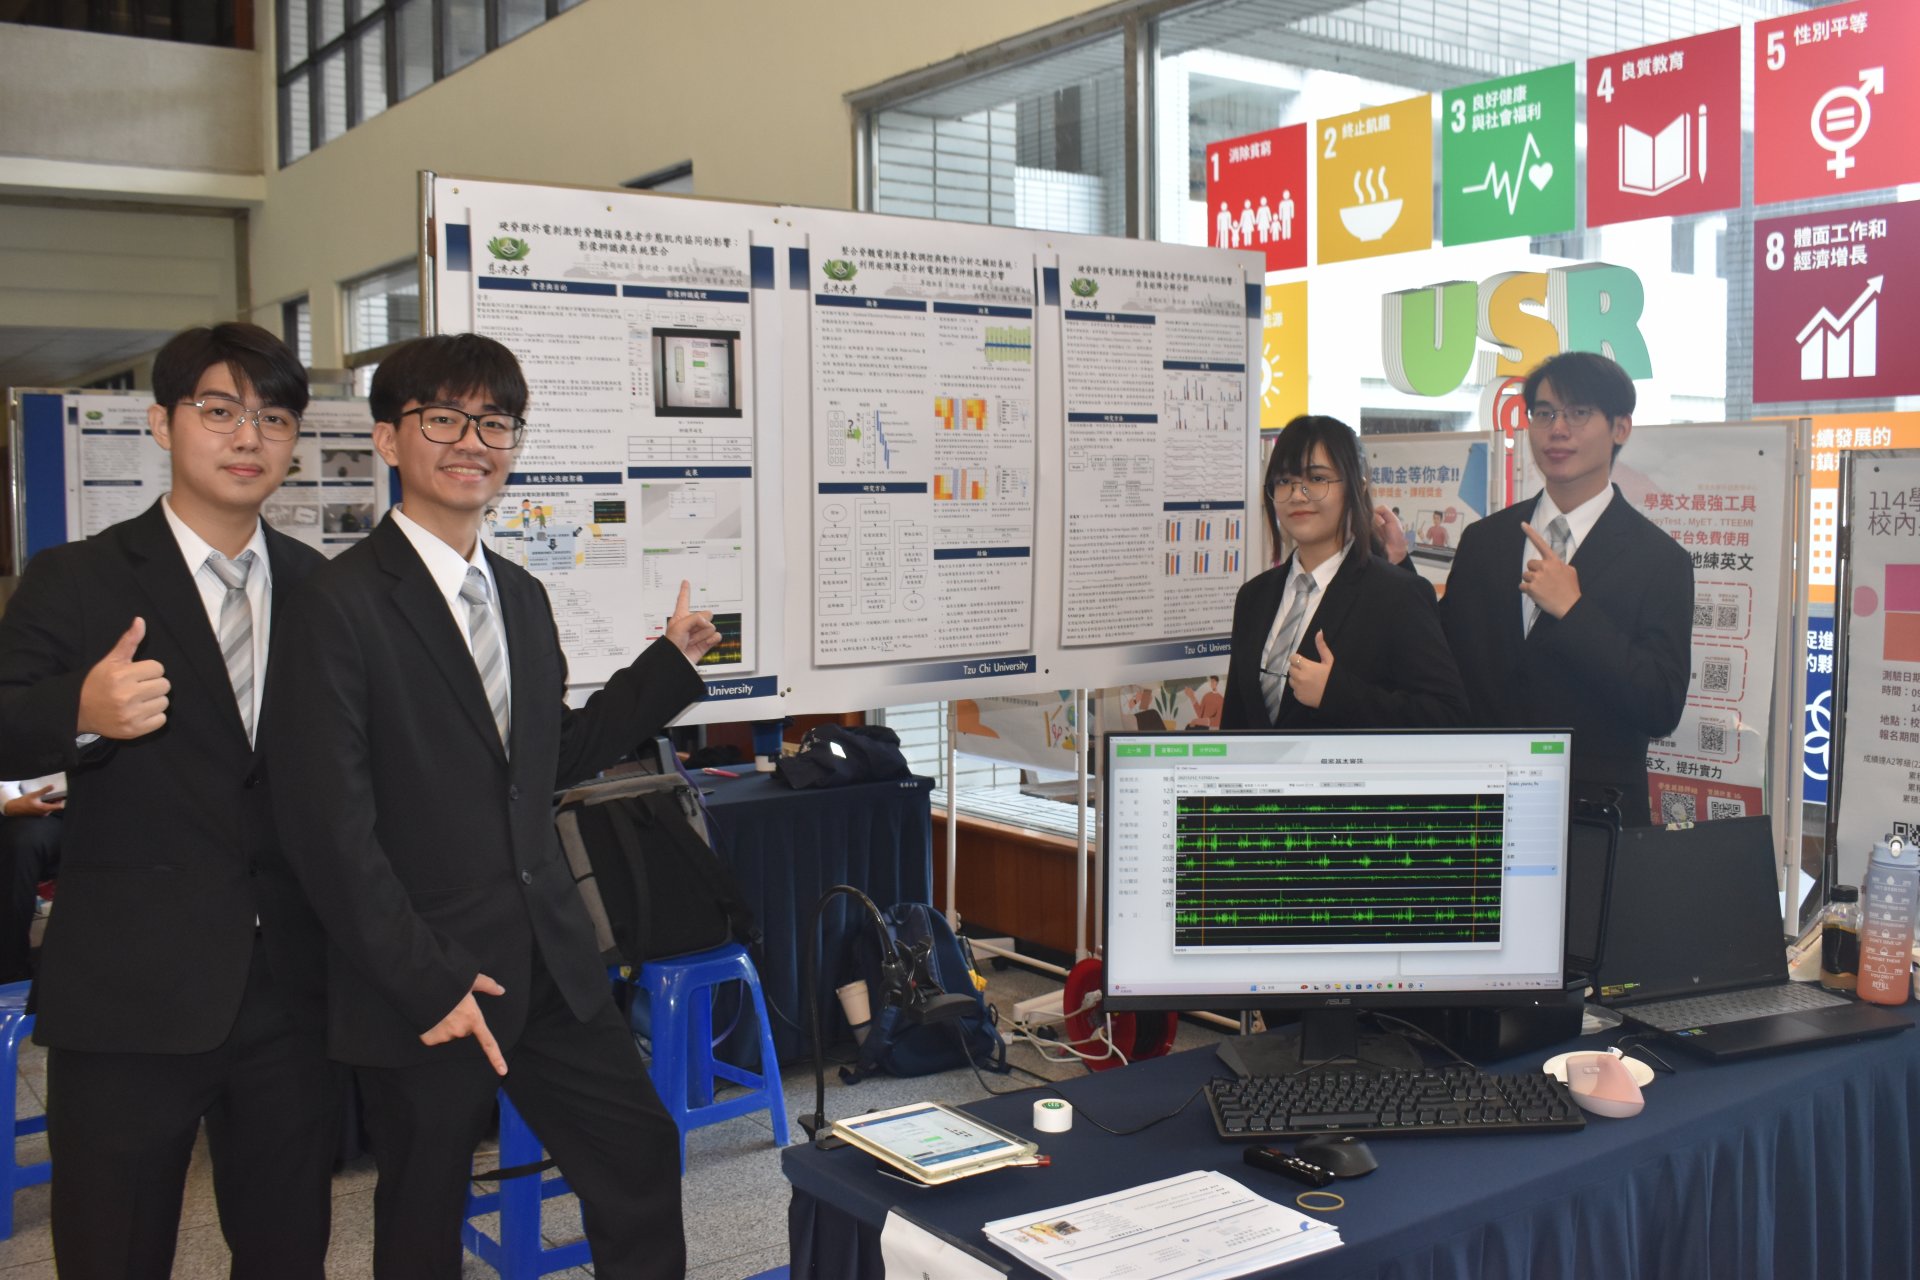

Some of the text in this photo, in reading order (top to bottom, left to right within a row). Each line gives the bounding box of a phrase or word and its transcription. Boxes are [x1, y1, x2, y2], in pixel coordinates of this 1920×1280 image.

[1794, 12, 1868, 46] 性別平等
[1767, 30, 1786, 71] 5
[1622, 51, 1684, 82] 良質教育
[1472, 84, 1528, 112] 良好健康
[1597, 67, 1614, 103] 4
[1342, 114, 1390, 139] 終止飢餓
[1451, 99, 1466, 134] 3
[1472, 102, 1541, 132] 與社會福利
[1324, 127, 1337, 159] 2
[1211, 152, 1219, 182] 1
[1794, 218, 1887, 248] 體面工作和
[1766, 232, 1784, 271] 8
[1793, 244, 1868, 272] 經濟增長
[1382, 262, 1653, 397] USR
[1812, 426, 1892, 448] 續發展的
[1644, 494, 1756, 512] 學英文最強工具
[1868, 511, 1920, 536] 校內
[1197, 644, 1208, 654] Chi
[963, 660, 1028, 674] Tzu Chi University
[708, 683, 753, 697] University
